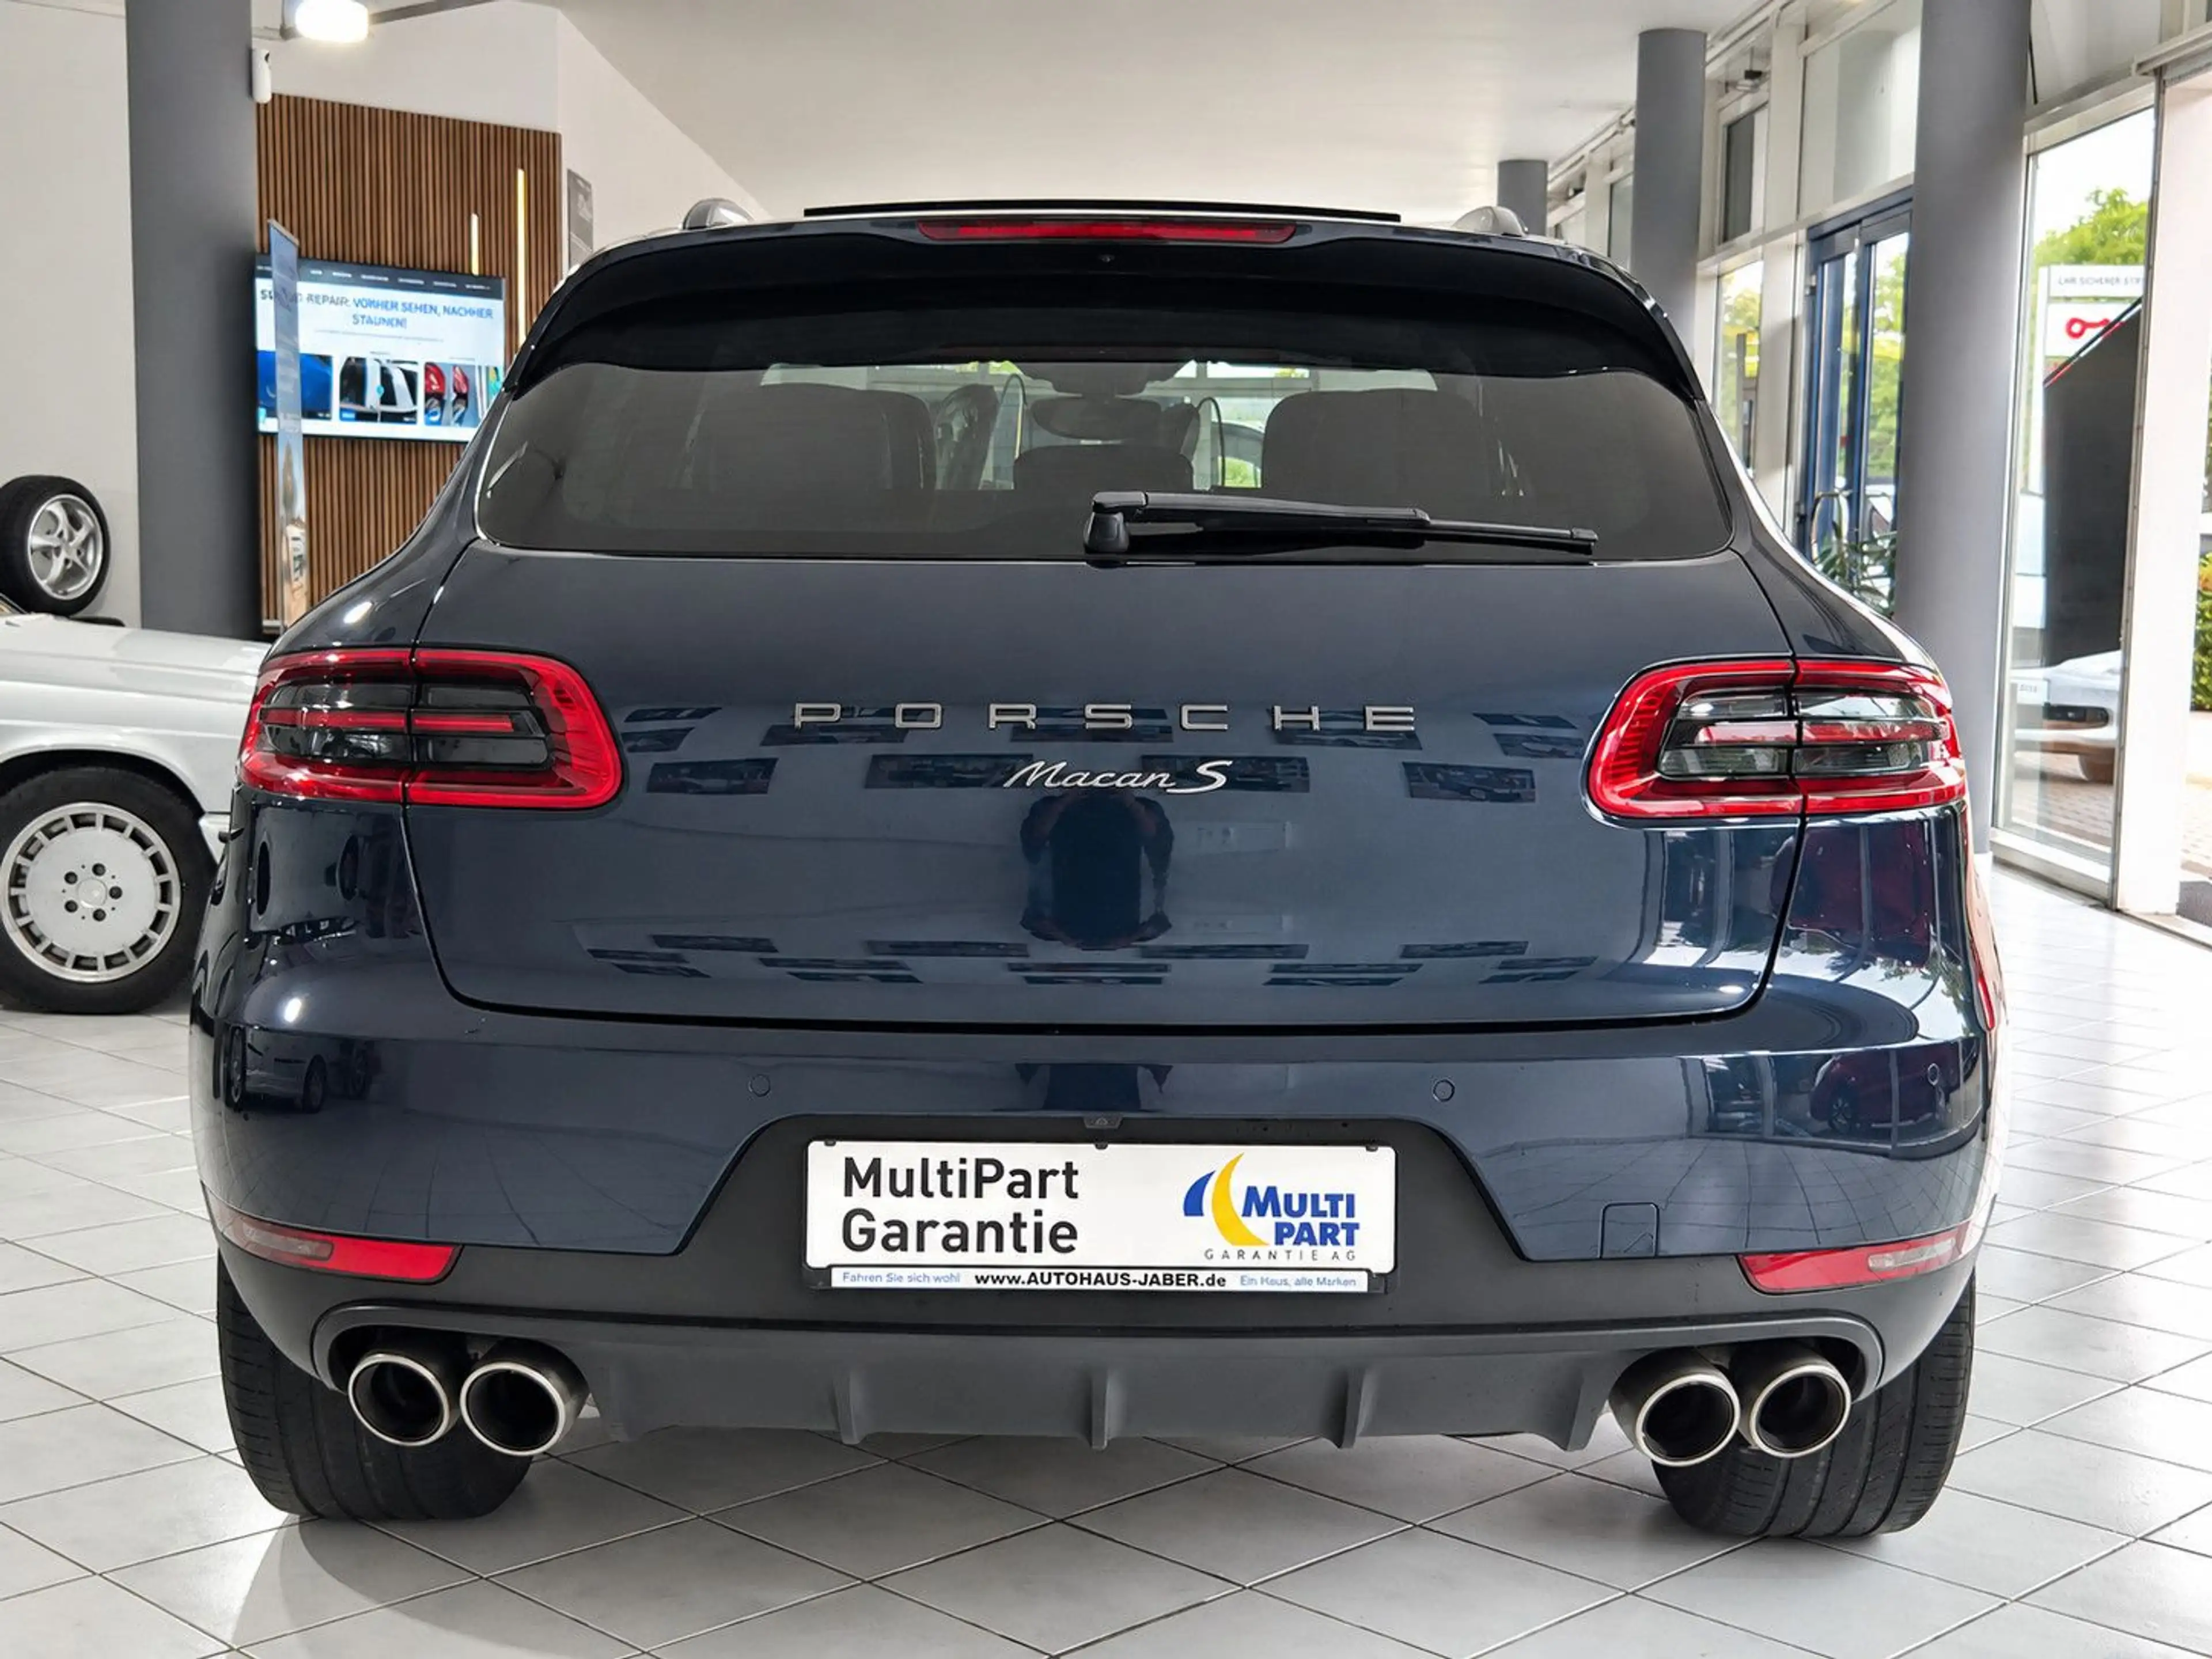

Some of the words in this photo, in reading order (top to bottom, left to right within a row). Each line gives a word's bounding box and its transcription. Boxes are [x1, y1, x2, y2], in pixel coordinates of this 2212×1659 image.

[353, 297, 399, 311] VORHER
[442, 305, 494, 319] NACHHER
[794, 703, 1416, 731] PORSCHE
[1003, 760, 1174, 791] Macan
[1166, 759, 1234, 794] S
[845, 1157, 1078, 1198] MultiPart
[1241, 1185, 1355, 1218] MULTI
[843, 1209, 1077, 1253] Garantie
[1274, 1222, 1360, 1246] PART
[1204, 1249, 1317, 1261] GARANTIE
[1332, 1249, 1355, 1261] AG
[843, 1272, 882, 1283] Fahren
[886, 1272, 903, 1283] Sie
[907, 1273, 930, 1283] sich
[975, 1271, 1226, 1287] www.AUTOHAUS-JABER.de
[1240, 1275, 1257, 1286] Ein
